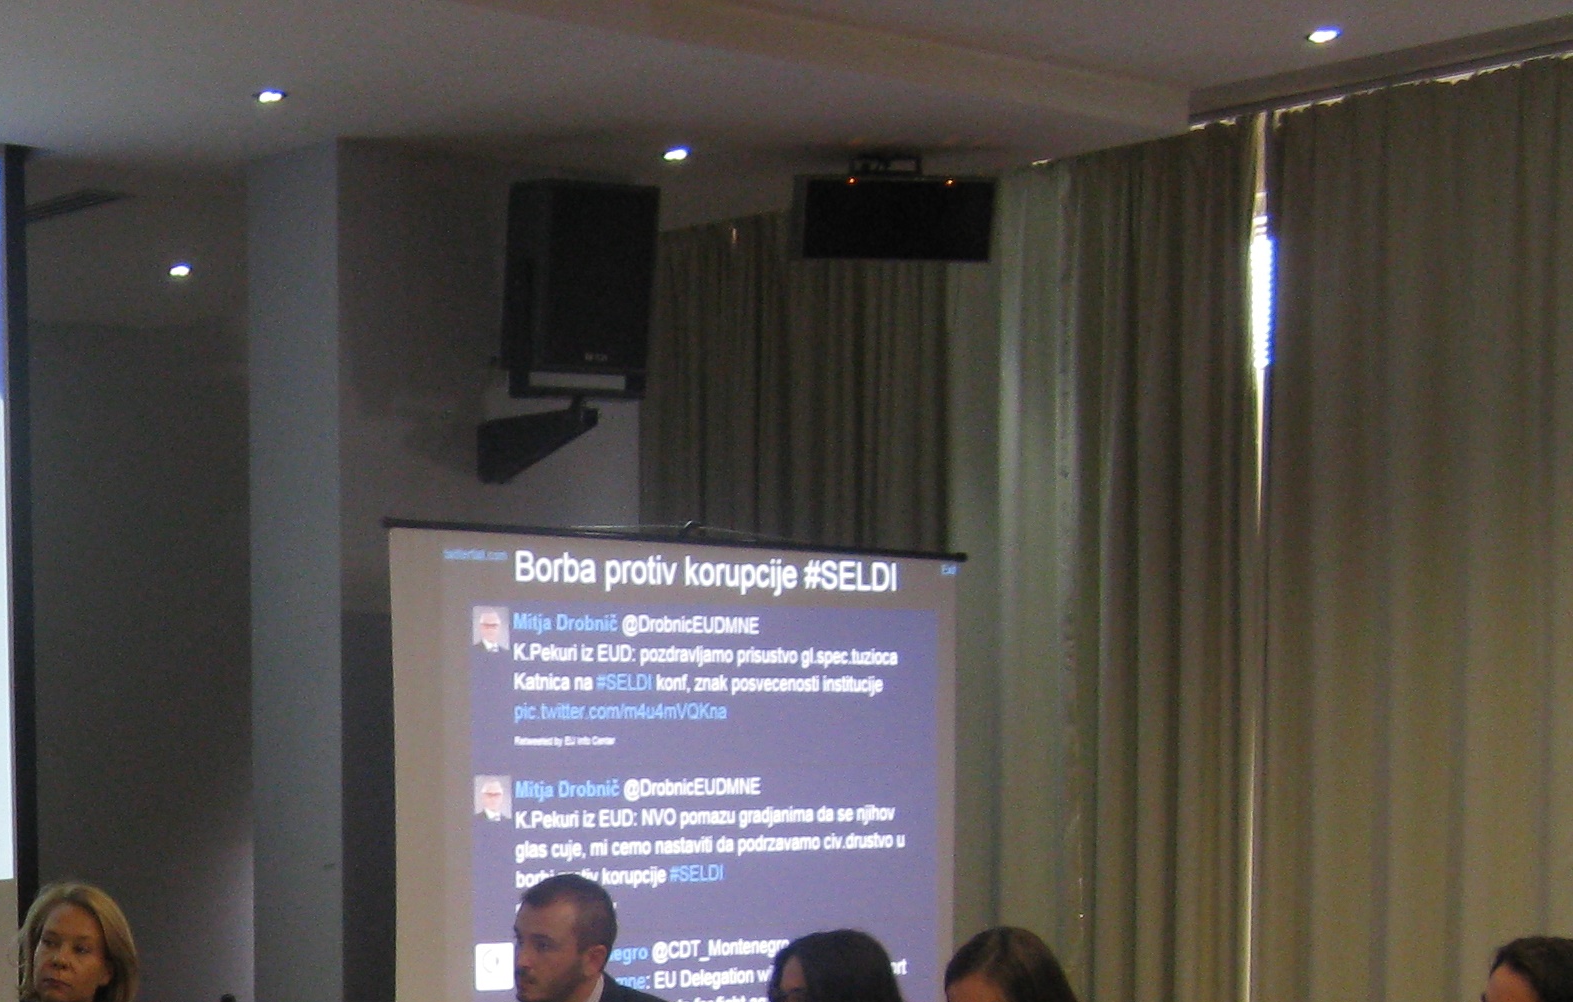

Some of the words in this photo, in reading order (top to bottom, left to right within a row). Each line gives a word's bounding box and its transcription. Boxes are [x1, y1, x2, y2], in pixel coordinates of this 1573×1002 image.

[515, 550, 597, 583] Borba
[604, 555, 678, 592] protiv
[685, 555, 798, 596] korupcije
[803, 559, 898, 592] #SELDI
[513, 613, 551, 635] Mitja
[556, 613, 618, 632] Drobnič
[622, 614, 760, 638] @DrobnicEUDMNE
[513, 643, 578, 662] K.Pekuri
[581, 644, 594, 662] iz
[598, 644, 636, 662] EUD:
[639, 645, 734, 667] pozdravljamo
[737, 646, 798, 667] prisustvo
[801, 647, 899, 669] gl.spec.tuzioca
[513, 672, 571, 692] Katnica
[574, 677, 593, 691] na
[596, 672, 652, 691] #SELDI
[656, 674, 691, 694] konf,
[694, 675, 729, 692] znak
[732, 675, 820, 696] posvecenosti
[822, 675, 884, 698] institucije
[515, 780, 553, 803] Mitja
[558, 778, 620, 798] Drobnič
[623, 777, 762, 801] @DrobnicEUDMNE
[515, 810, 579, 829] K.Pekuri
[582, 809, 596, 828] iz
[599, 809, 638, 828] EUD:
[641, 808, 677, 826] NVO
[680, 810, 736, 829] pomazu
[738, 805, 814, 829] gradjanima
[817, 806, 835, 823] da
[837, 807, 854, 822] se
[856, 804, 896, 825] njihov
[515, 840, 548, 863] glas
[551, 839, 587, 862] cuje,
[589, 839, 609, 857] mi
[612, 840, 652, 856] cemo
[654, 836, 714, 856] nastaviti
[716, 835, 735, 853] da
[737, 834, 821, 856] podrzavamo
[823, 832, 894, 850] civ.drustvo
[896, 833, 906, 849] u
[601, 866, 667, 888] korupcije
[669, 864, 724, 882] #SELDI
[654, 970, 677, 989] EU
[680, 968, 755, 991] Delegation
